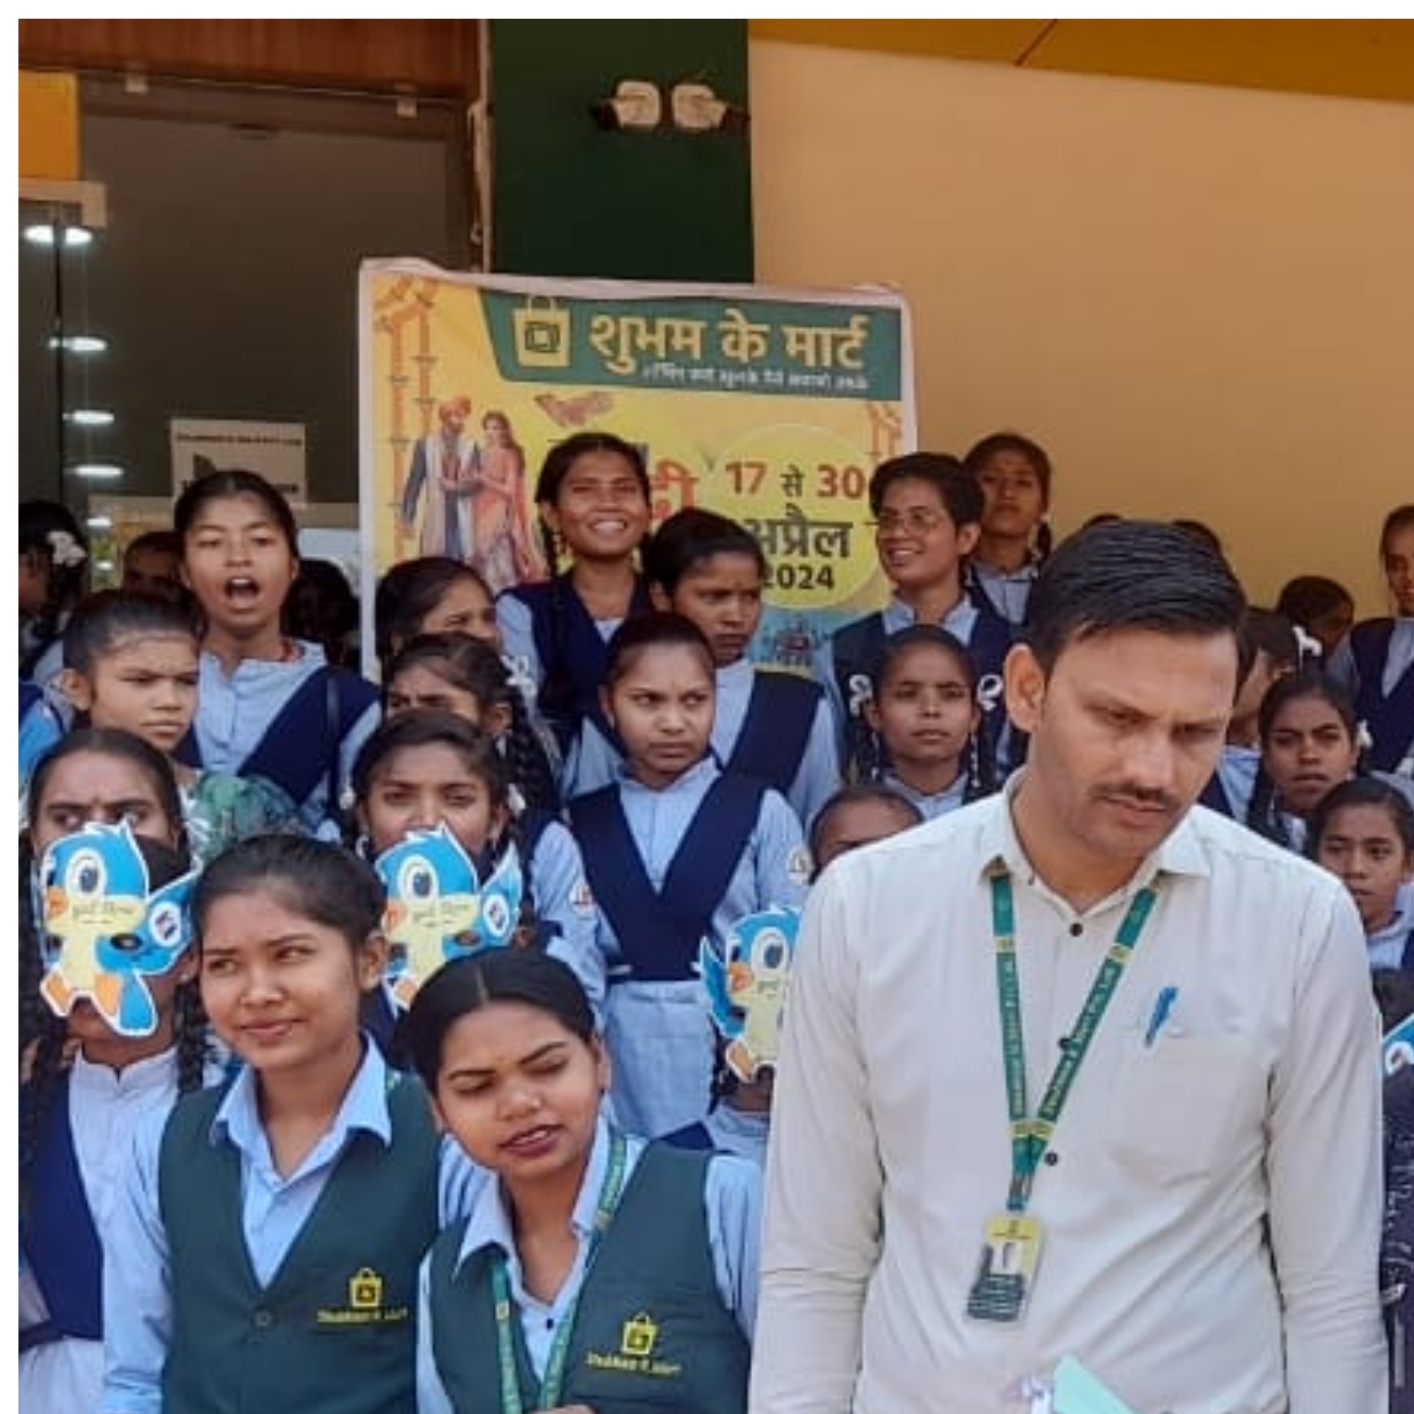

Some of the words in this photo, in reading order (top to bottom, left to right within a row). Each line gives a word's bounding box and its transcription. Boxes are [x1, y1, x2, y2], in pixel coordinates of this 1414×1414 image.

[589, 314, 707, 374] शुभम
[717, 308, 770, 363] के
[781, 315, 870, 368] मार्ट
[726, 461, 768, 494] 17
[782, 465, 805, 497] से
[816, 464, 866, 499] 30
